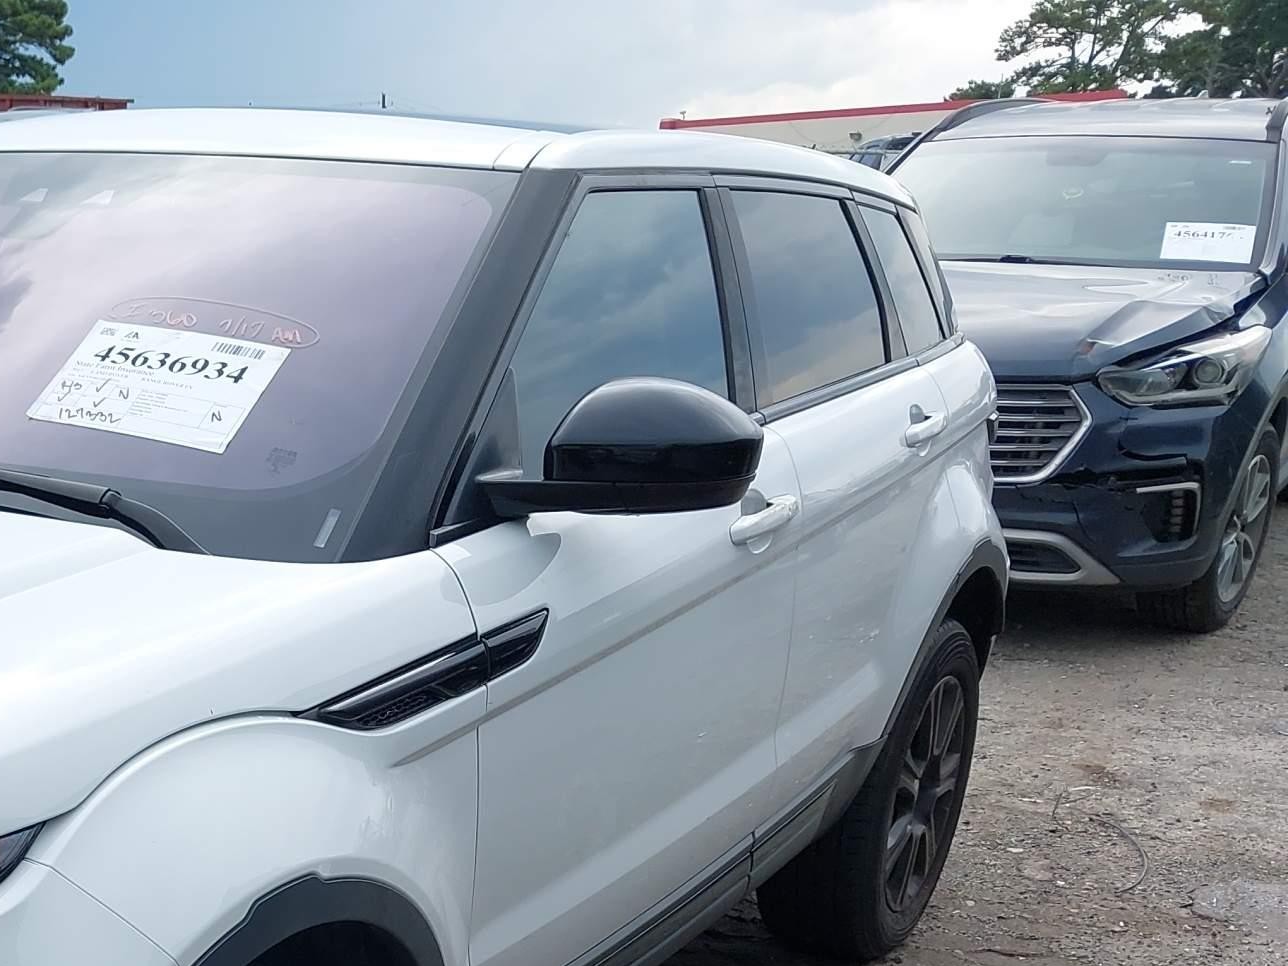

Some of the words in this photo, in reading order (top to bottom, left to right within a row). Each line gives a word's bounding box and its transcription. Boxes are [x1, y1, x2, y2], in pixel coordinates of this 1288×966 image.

[93, 345, 249, 384] 45636934
[118, 387, 130, 400] N
[210, 410, 223, 423] N
